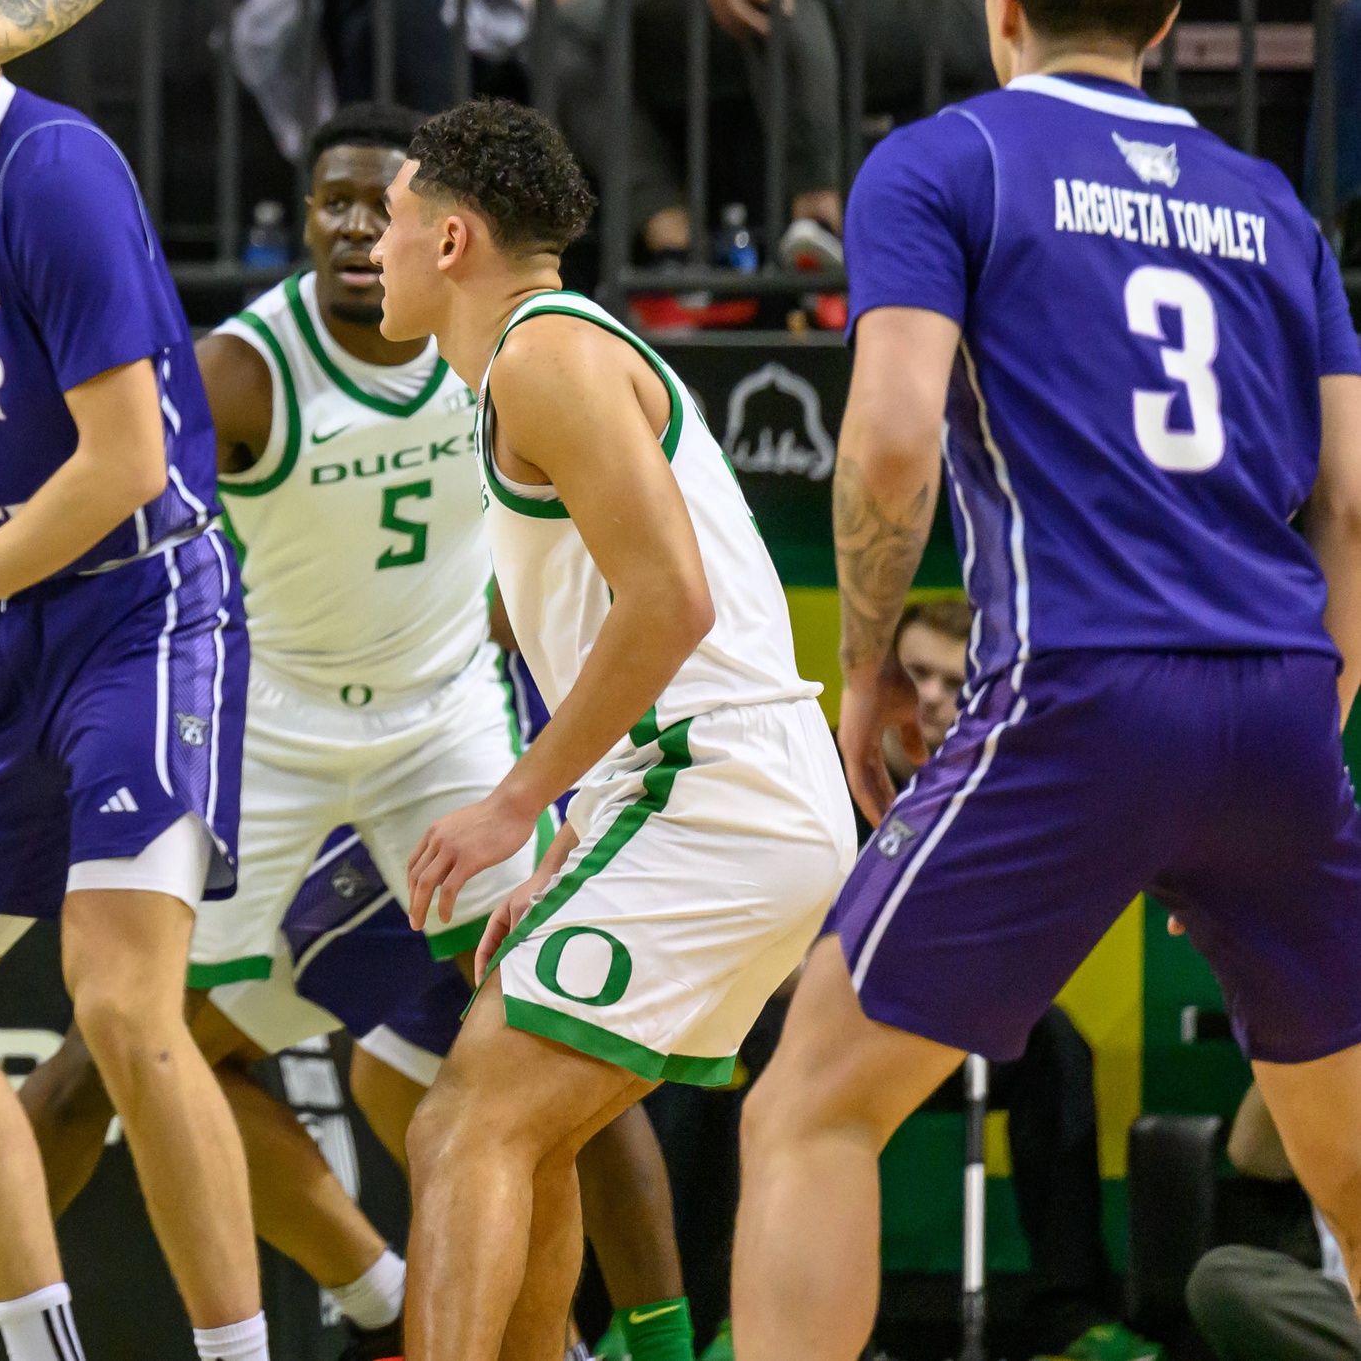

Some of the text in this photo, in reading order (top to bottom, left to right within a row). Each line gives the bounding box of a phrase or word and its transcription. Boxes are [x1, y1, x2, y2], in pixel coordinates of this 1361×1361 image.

[1054, 177, 1267, 266] ARGUETA TOMLEY
[1123, 263, 1228, 474] 3
[375, 478, 433, 571] 5
